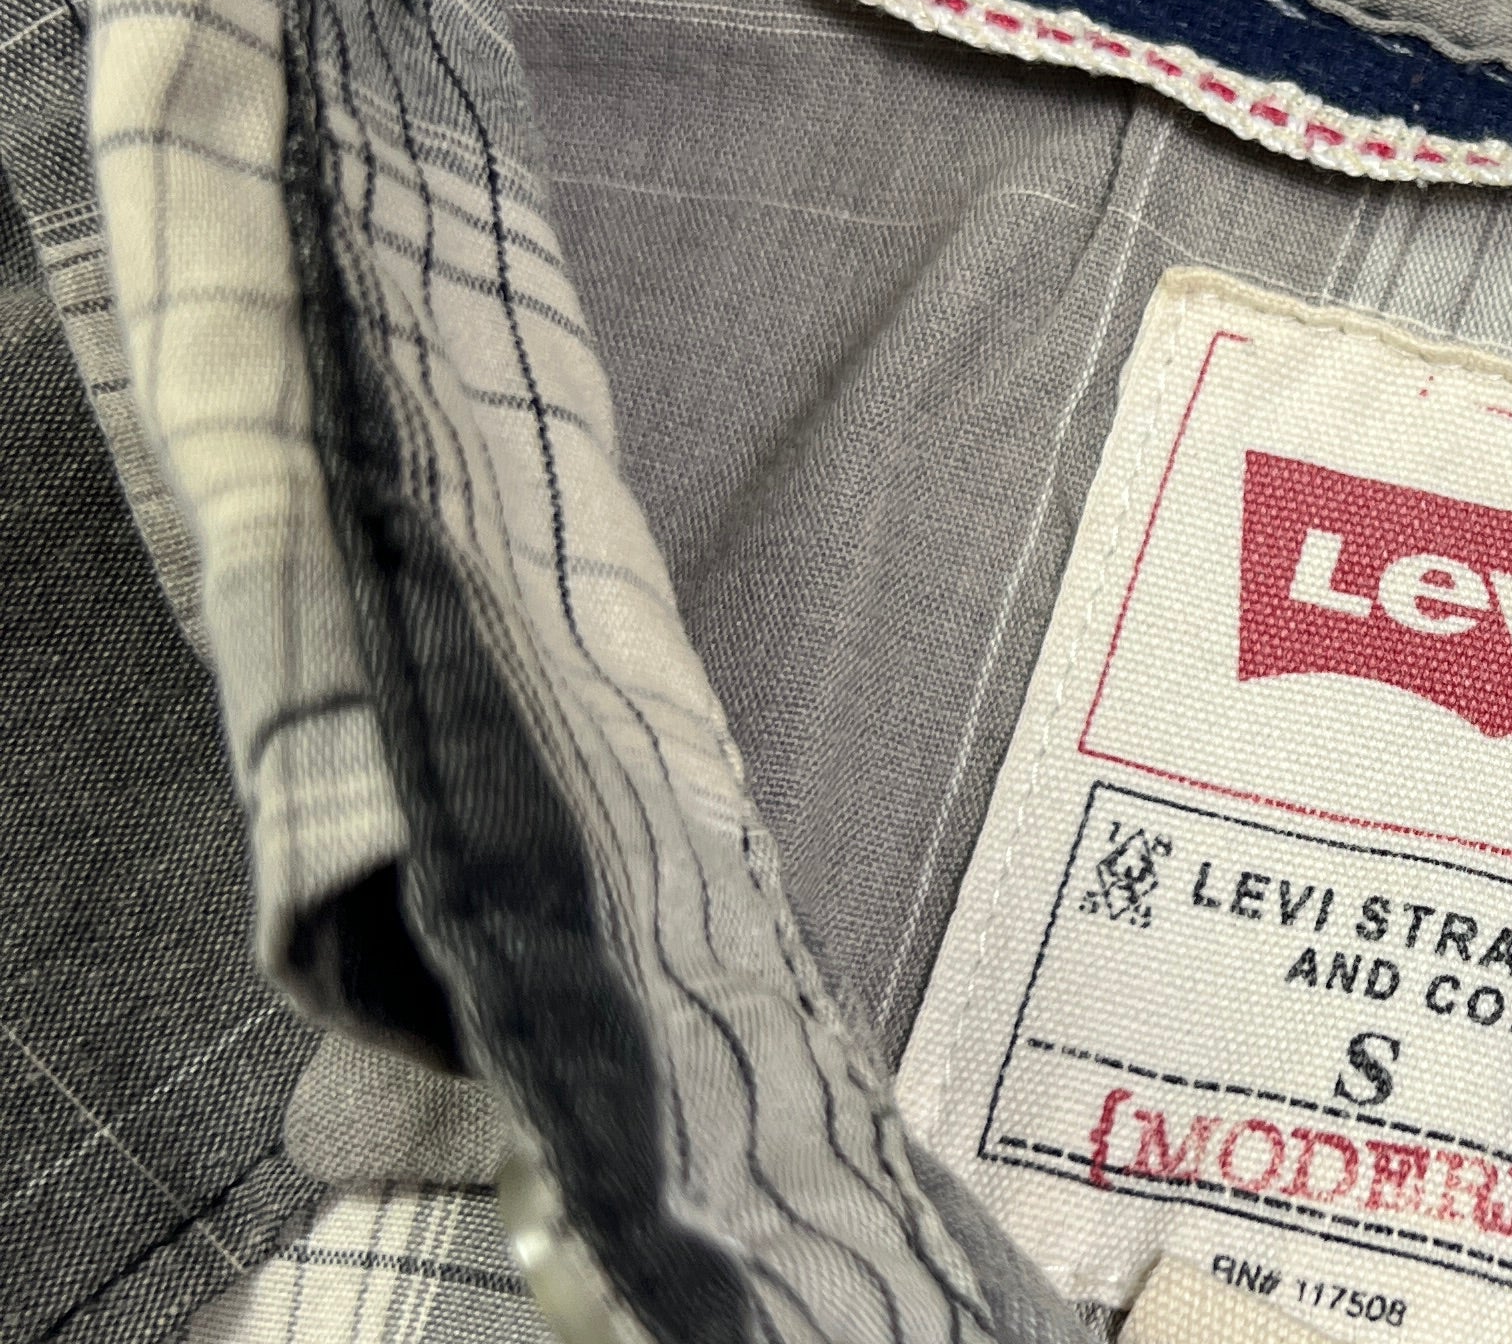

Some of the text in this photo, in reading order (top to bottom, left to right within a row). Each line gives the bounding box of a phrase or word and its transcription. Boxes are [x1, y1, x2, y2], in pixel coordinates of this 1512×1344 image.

[1192, 861, 1335, 932] LEVI
[1284, 946, 1401, 1001] AND
[1333, 1030, 1401, 1107] S
[1211, 1253, 1408, 1328] RN# 117508
